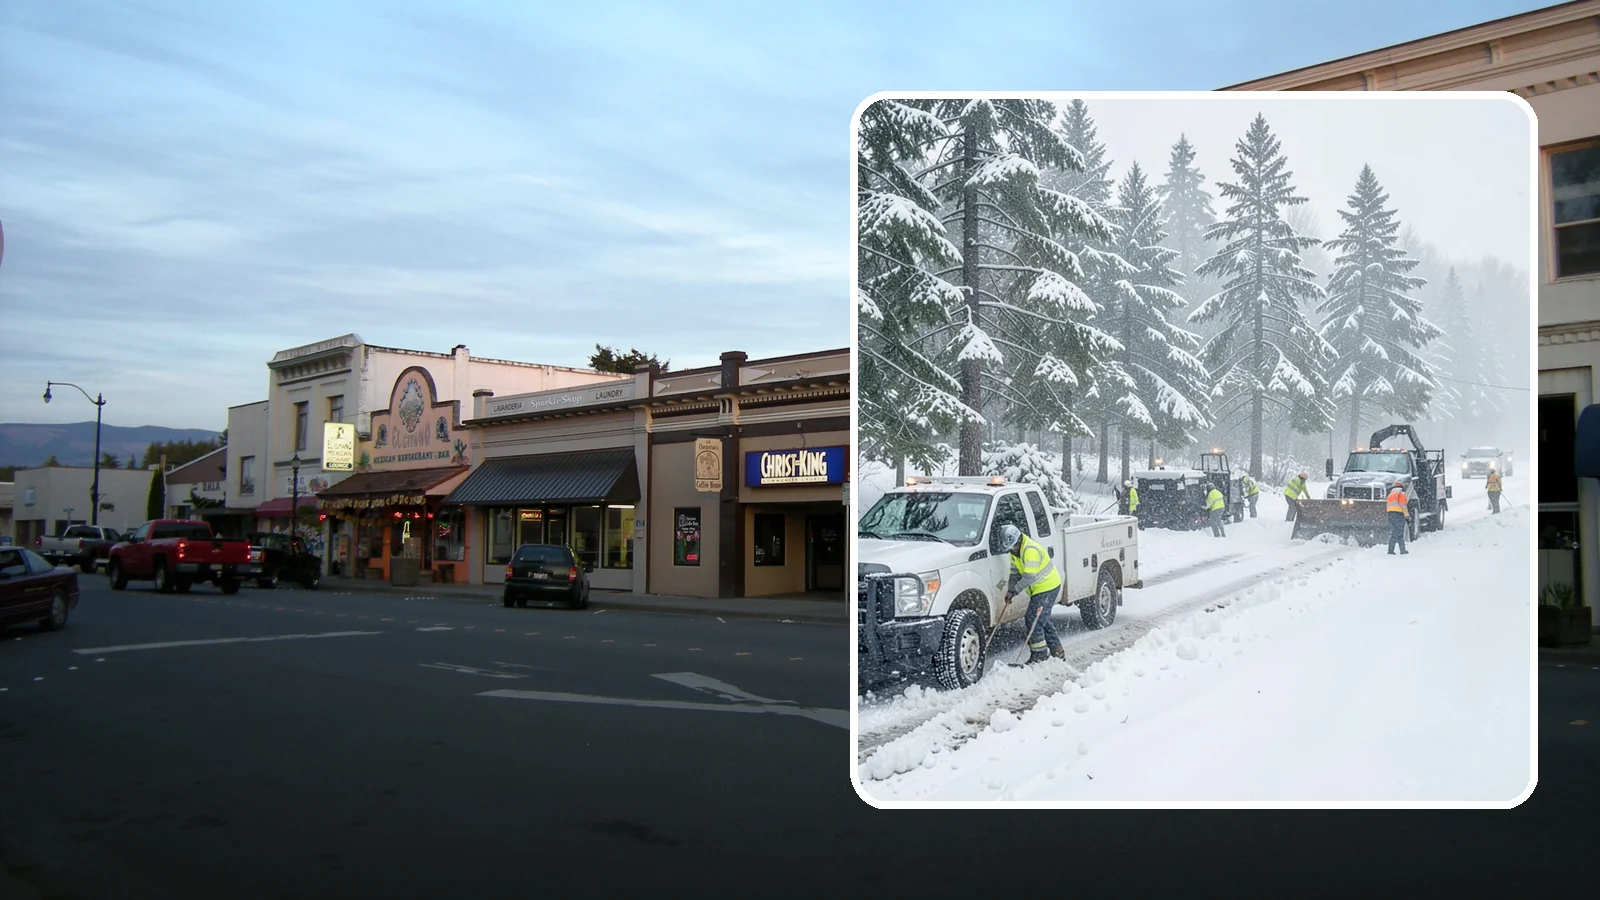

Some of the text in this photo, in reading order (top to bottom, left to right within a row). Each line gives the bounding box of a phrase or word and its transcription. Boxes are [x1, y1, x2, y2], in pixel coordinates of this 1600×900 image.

[493, 389, 623, 412] LAVANDERIA Sparkle Shop LAUNDRY
[374, 455, 397, 464] MEXICAN
[398, 452, 433, 462] RESTAURANT
[438, 450, 450, 459] BAR
[761, 450, 828, 478] CHRIST KING
[697, 481, 722, 489] Coffee House
